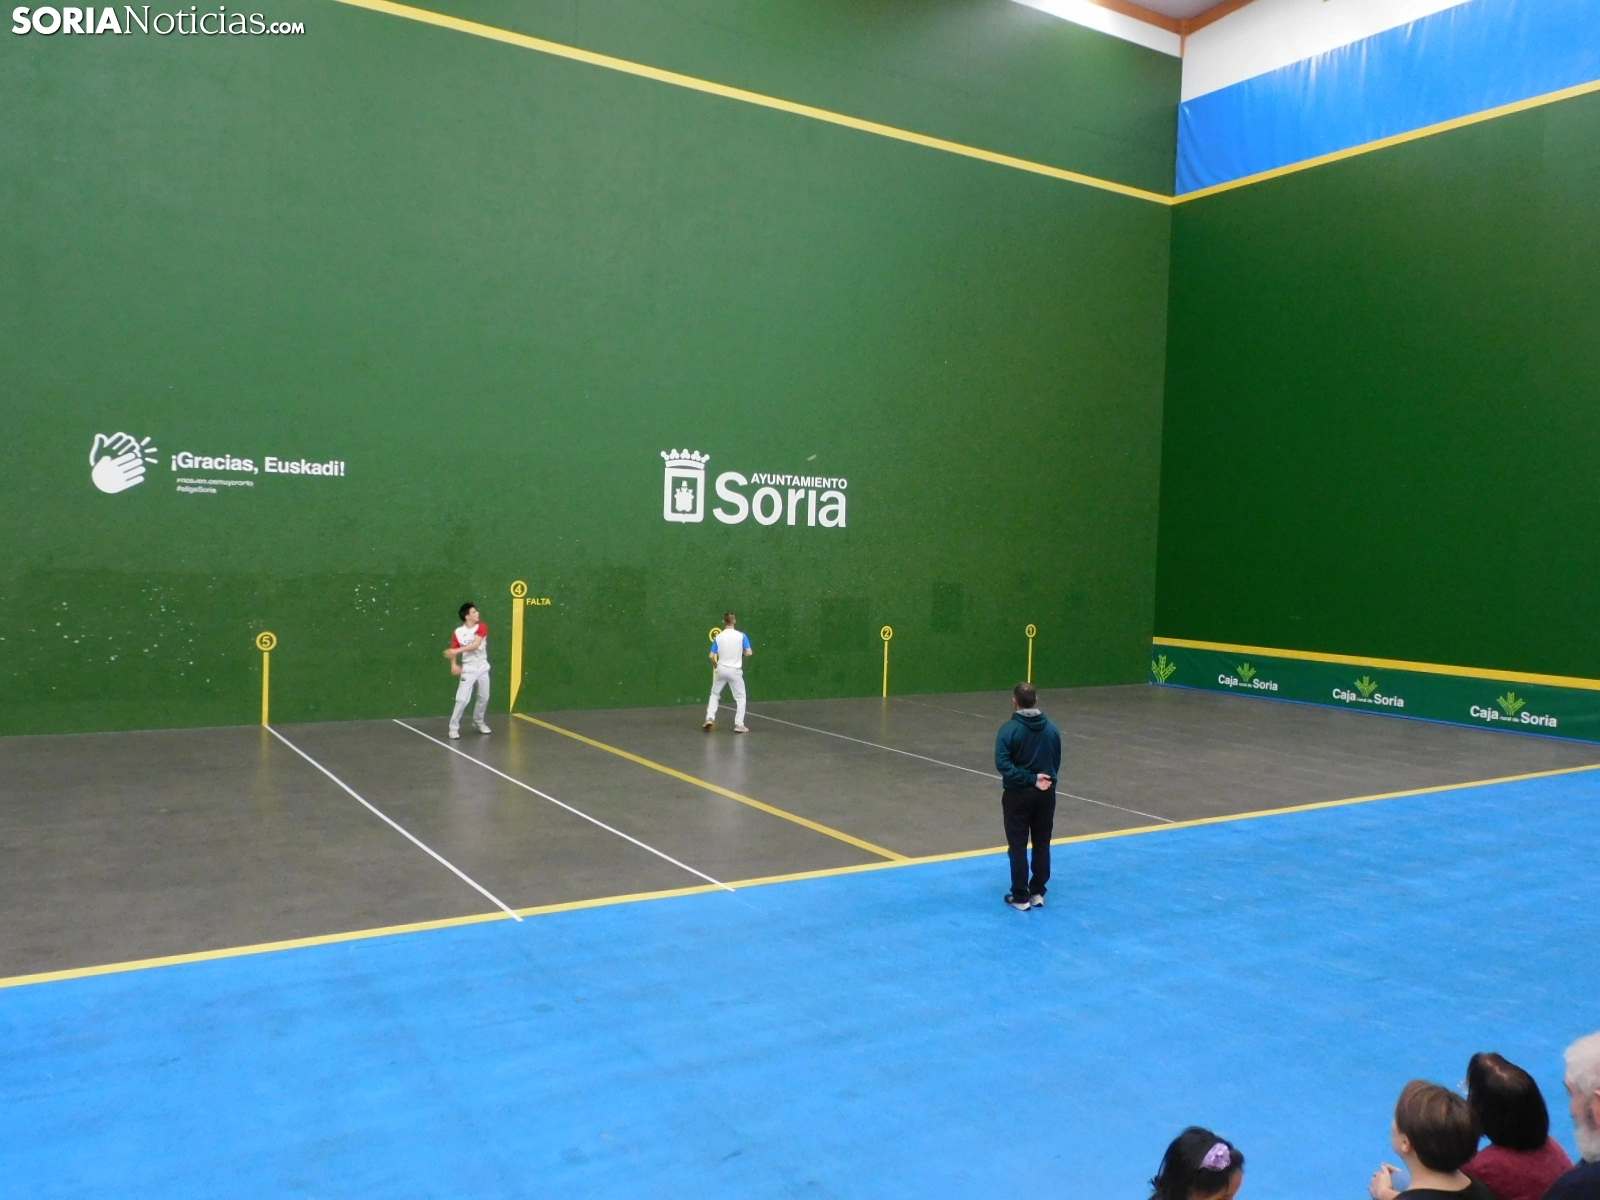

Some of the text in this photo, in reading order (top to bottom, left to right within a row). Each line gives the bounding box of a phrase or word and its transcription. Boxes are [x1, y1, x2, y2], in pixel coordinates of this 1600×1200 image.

[171, 451, 346, 476] ¡Gracias, Euskadi!
[751, 473, 848, 490] AYUNTAMIENTO
[713, 471, 847, 528] Soria
[526, 598, 551, 606] FALTA
[1218, 674, 1239, 688] Caja
[1253, 678, 1279, 691] Soria
[1332, 688, 1357, 703] Caja
[1373, 693, 1405, 707] Soria
[1469, 705, 1499, 722] Caja
[1520, 711, 1557, 728] Soria
